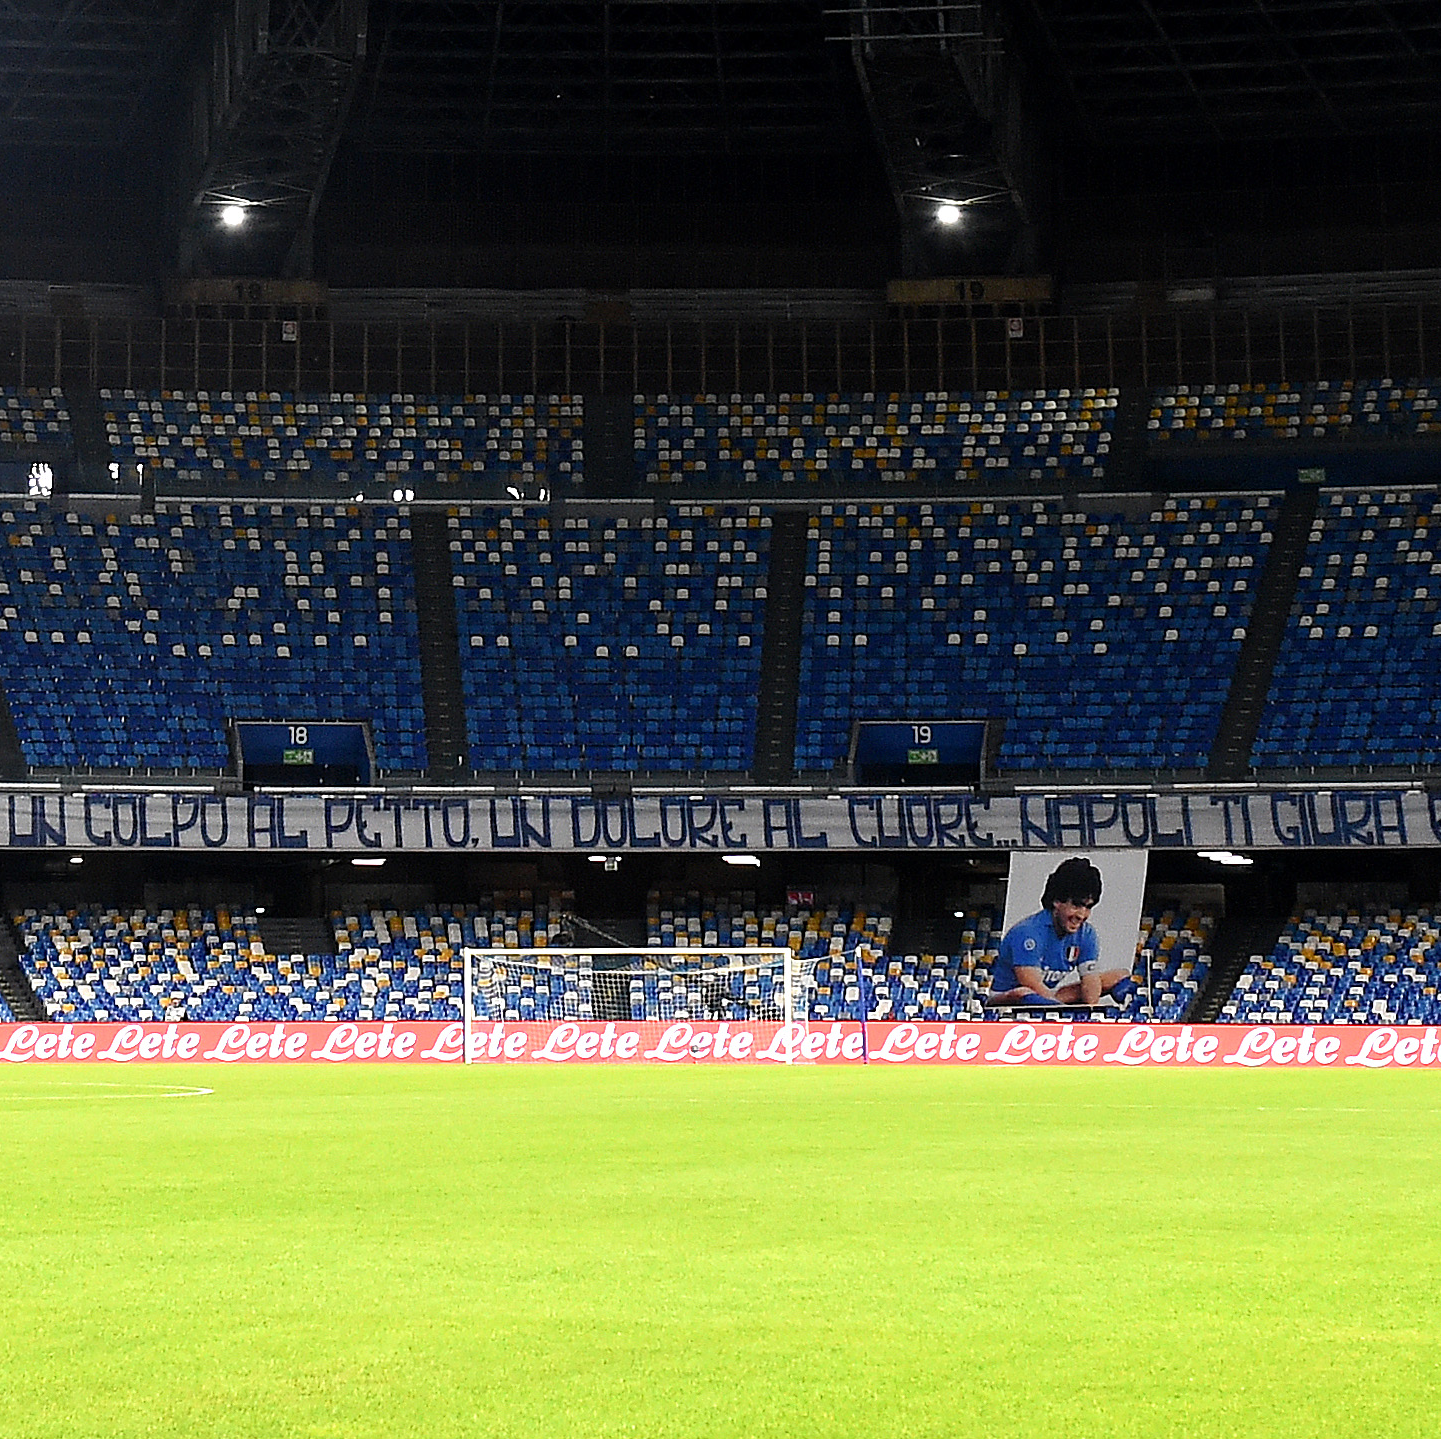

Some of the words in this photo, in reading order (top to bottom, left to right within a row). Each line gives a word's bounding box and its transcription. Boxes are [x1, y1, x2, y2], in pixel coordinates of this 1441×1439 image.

[288, 726, 308, 745] 18
[912, 725, 932, 744] 19
[9, 794, 66, 845] UN
[84, 795, 227, 848] COLPO
[247, 796, 307, 848] AL
[325, 796, 480, 848] PETTO,
[492, 796, 551, 848] UN
[571, 796, 747, 848] DOLORE
[762, 795, 826, 848] AL
[1020, 793, 1193, 848] NAPOLI
[1211, 793, 1253, 847] TI
[1272, 792, 1409, 846] GIURA
[97, 1024, 200, 1061] Lete
[203, 1023, 307, 1061] Lete
[310, 1023, 416, 1061] Lete
[420, 1022, 528, 1062] Lete
[531, 1022, 639, 1061] Lete
[643, 1022, 753, 1061] Lete
[756, 1022, 864, 1061] Lete
[868, 1023, 980, 1062] Lete
[985, 1024, 1098, 1064] Lete
[1103, 1025, 1218, 1065] Lete
[1223, 1026, 1340, 1067] Lete
